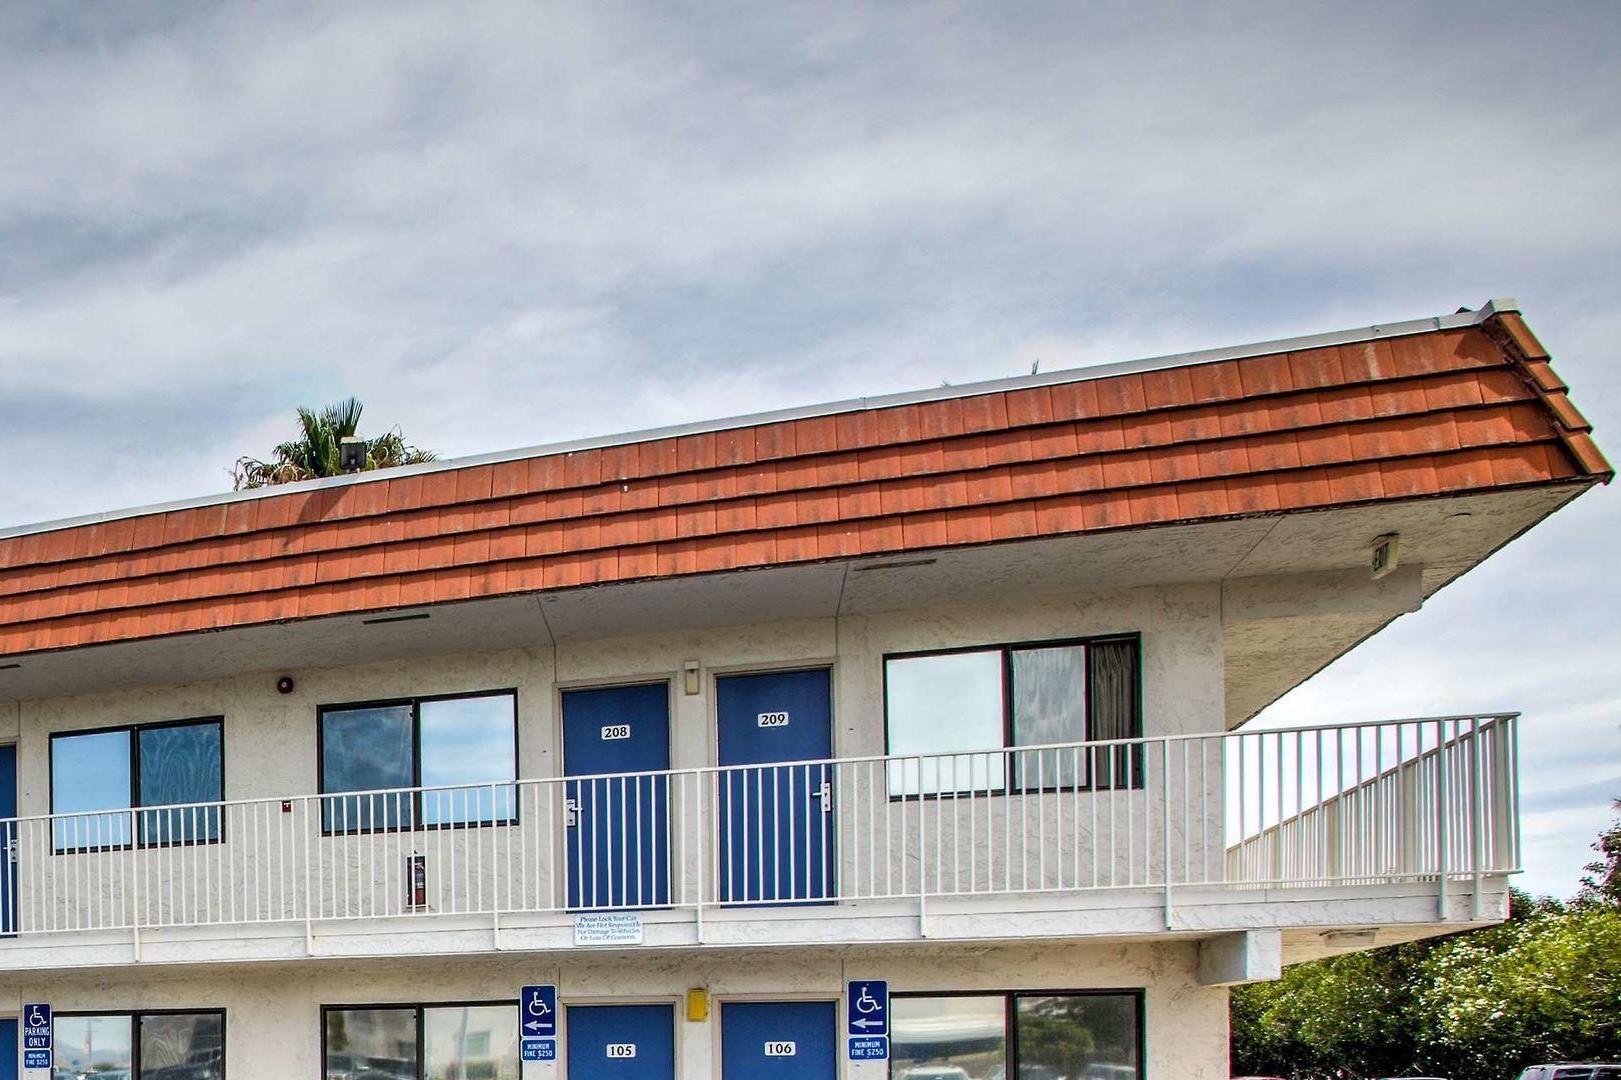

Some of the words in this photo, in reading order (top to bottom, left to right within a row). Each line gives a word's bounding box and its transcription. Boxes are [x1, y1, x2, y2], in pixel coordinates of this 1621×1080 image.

[761, 714, 785, 725] 209
[604, 727, 627, 738] 208
[25, 1027, 49, 1036] PARKING
[28, 1037, 46, 1047] ONLY
[854, 1041, 880, 1049] MINIMUM
[610, 1045, 632, 1056] 105
[768, 1043, 792, 1054] 106
[851, 1048, 864, 1056] FINE
[867, 1048, 884, 1056] $250
